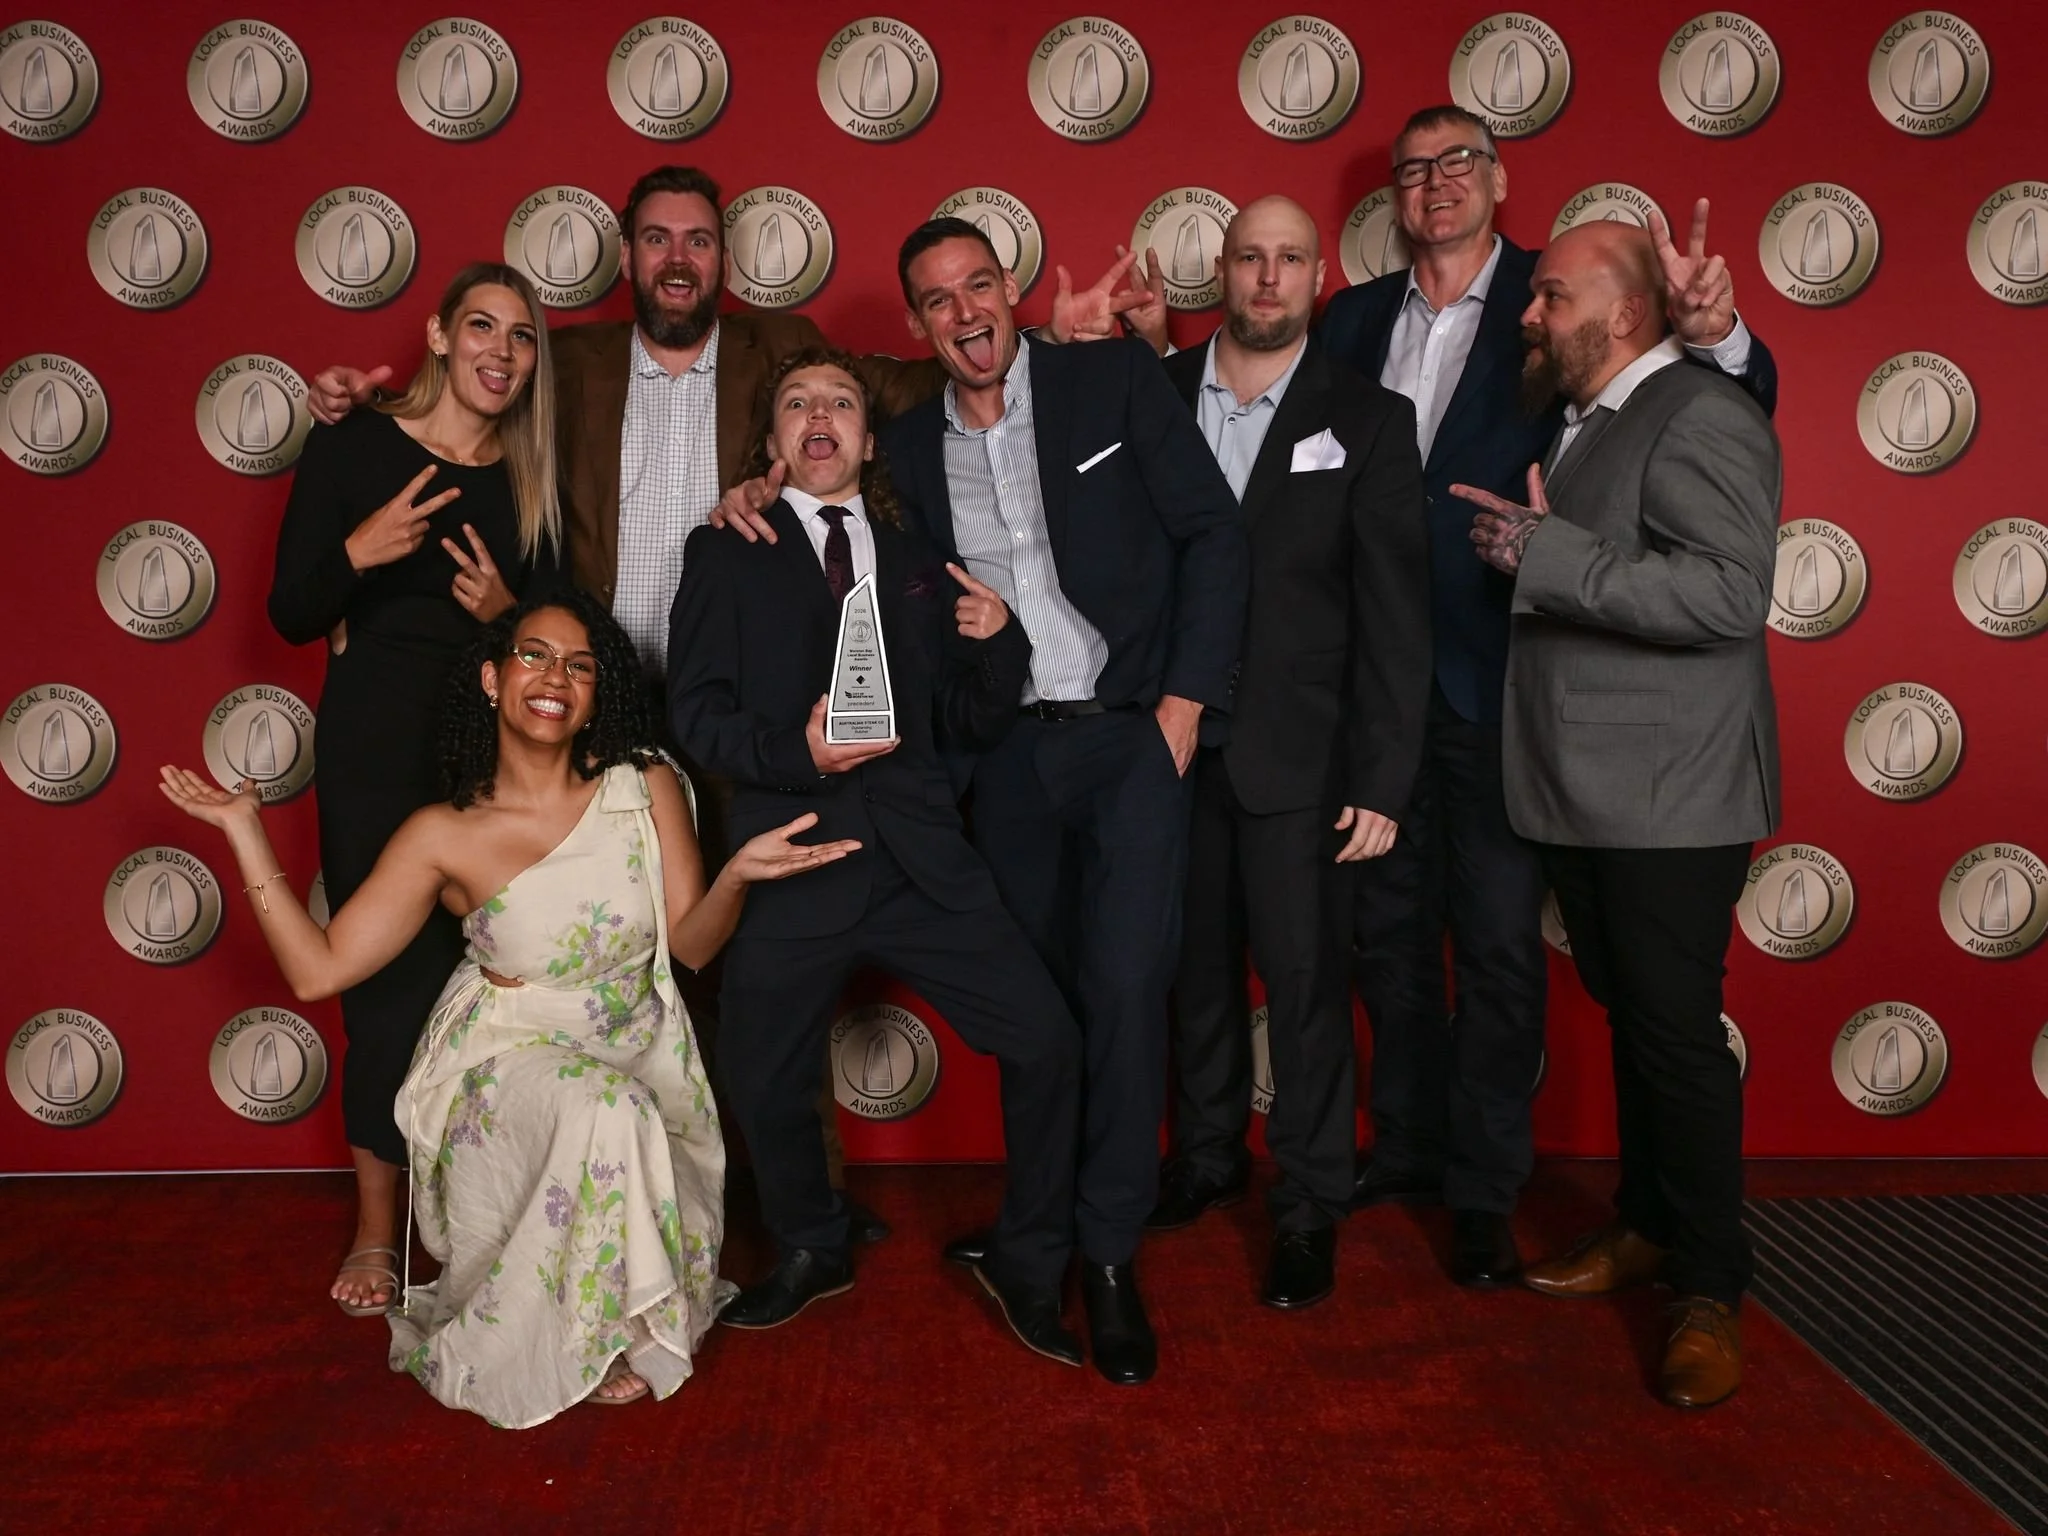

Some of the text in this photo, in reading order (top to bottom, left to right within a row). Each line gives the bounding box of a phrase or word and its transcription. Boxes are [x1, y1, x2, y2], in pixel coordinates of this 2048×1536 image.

[0, 24, 87, 65] CAL BUSINESS
[195, 24, 297, 64] LOCAL BUSINESS
[405, 22, 507, 62] LOCAL BUSINESS
[616, 21, 718, 62] LOCAL BUSINESS
[826, 21, 928, 63] LOCAL BUSINESS
[1037, 21, 1139, 63] LOCAL BUSINESS
[1247, 20, 1350, 61] LOCAL BUSINESS
[1459, 17, 1561, 59] LOCAL BUSINESS
[1669, 16, 1770, 58] LOCAL BUSINESS
[1878, 15, 1980, 56] LOCAL BUSINESS
[8, 119, 67, 138] AWARDS
[216, 119, 276, 137] AWARDS
[426, 117, 486, 135] AWARDS
[635, 117, 695, 135] AWARDS
[845, 118, 905, 136] AWARDS
[1055, 118, 1115, 136] AWARDS
[1266, 117, 1326, 135] AWARDS
[1686, 113, 1746, 132] AWARDS
[1895, 112, 1955, 131] AWARDS
[95, 192, 197, 232] LOCAL BUSINESS
[303, 191, 405, 231] LOCAL BUSINESS
[513, 190, 614, 231] LOCAL BUSINESS
[723, 190, 822, 231] LOCAL BUSINESS
[936, 191, 1032, 232] OCAL BUSINESS
[1139, 191, 1234, 229] LOCAL BUSINE
[1349, 193, 1388, 227] LOCAL
[1559, 187, 1652, 225] LOCAL BUSINE
[1768, 187, 1869, 228] LOCAL BUSINESS
[1977, 189, 2015, 224] LOCAL
[117, 286, 176, 304] AWARDS
[324, 286, 384, 304] AWARDS
[536, 286, 592, 304] AWARDS
[740, 286, 800, 304] AWARDS
[1785, 283, 1845, 301] AWARDS
[0, 358, 97, 398] LOCAL BUSINESS
[204, 358, 304, 398] LOCAL BUSINESS
[1866, 356, 1966, 396] LOCAL BUSINESS
[18, 452, 77, 470] AWARDS
[225, 453, 283, 470] AWARDS
[1883, 451, 1942, 468] AWARDS
[104, 524, 205, 564] LOCAL BUSINESS
[1803, 523, 1857, 562] BUSINESS
[1963, 522, 2048, 559] LOCAL BUSIN
[125, 617, 184, 635] AWARDS
[1774, 616, 1833, 633] AWARDS
[1979, 615, 2037, 632] AWARDS
[6, 688, 105, 727] LOCAL BUSINESS
[211, 688, 311, 728] LOCAL BUSINESS
[1854, 686, 1953, 726] LOCAL BUSINESS
[27, 780, 85, 798] AWARDS
[1870, 778, 1928, 795] AWARDS
[111, 851, 211, 890] LOCAL BUSINESS
[1746, 848, 1844, 886] LOCAL BUSINESS
[1948, 846, 2047, 885] LOCAL BUSINESS
[132, 942, 191, 959] AWARDS
[1762, 937, 1820, 955] AWARDS
[1964, 936, 2022, 953] AWARDS
[14, 1012, 112, 1051] LOCAL BUSINESS
[217, 1011, 317, 1050] LOCAL BUSINESS
[875, 1007, 929, 1046] BUSINESS
[1841, 1005, 1938, 1043] LOCAL BUSINESS
[34, 1104, 92, 1121] AWARDS
[237, 1101, 296, 1118] AWARDS
[848, 1097, 907, 1114] AWARDS
[1856, 1094, 1914, 1111] AWARDS
